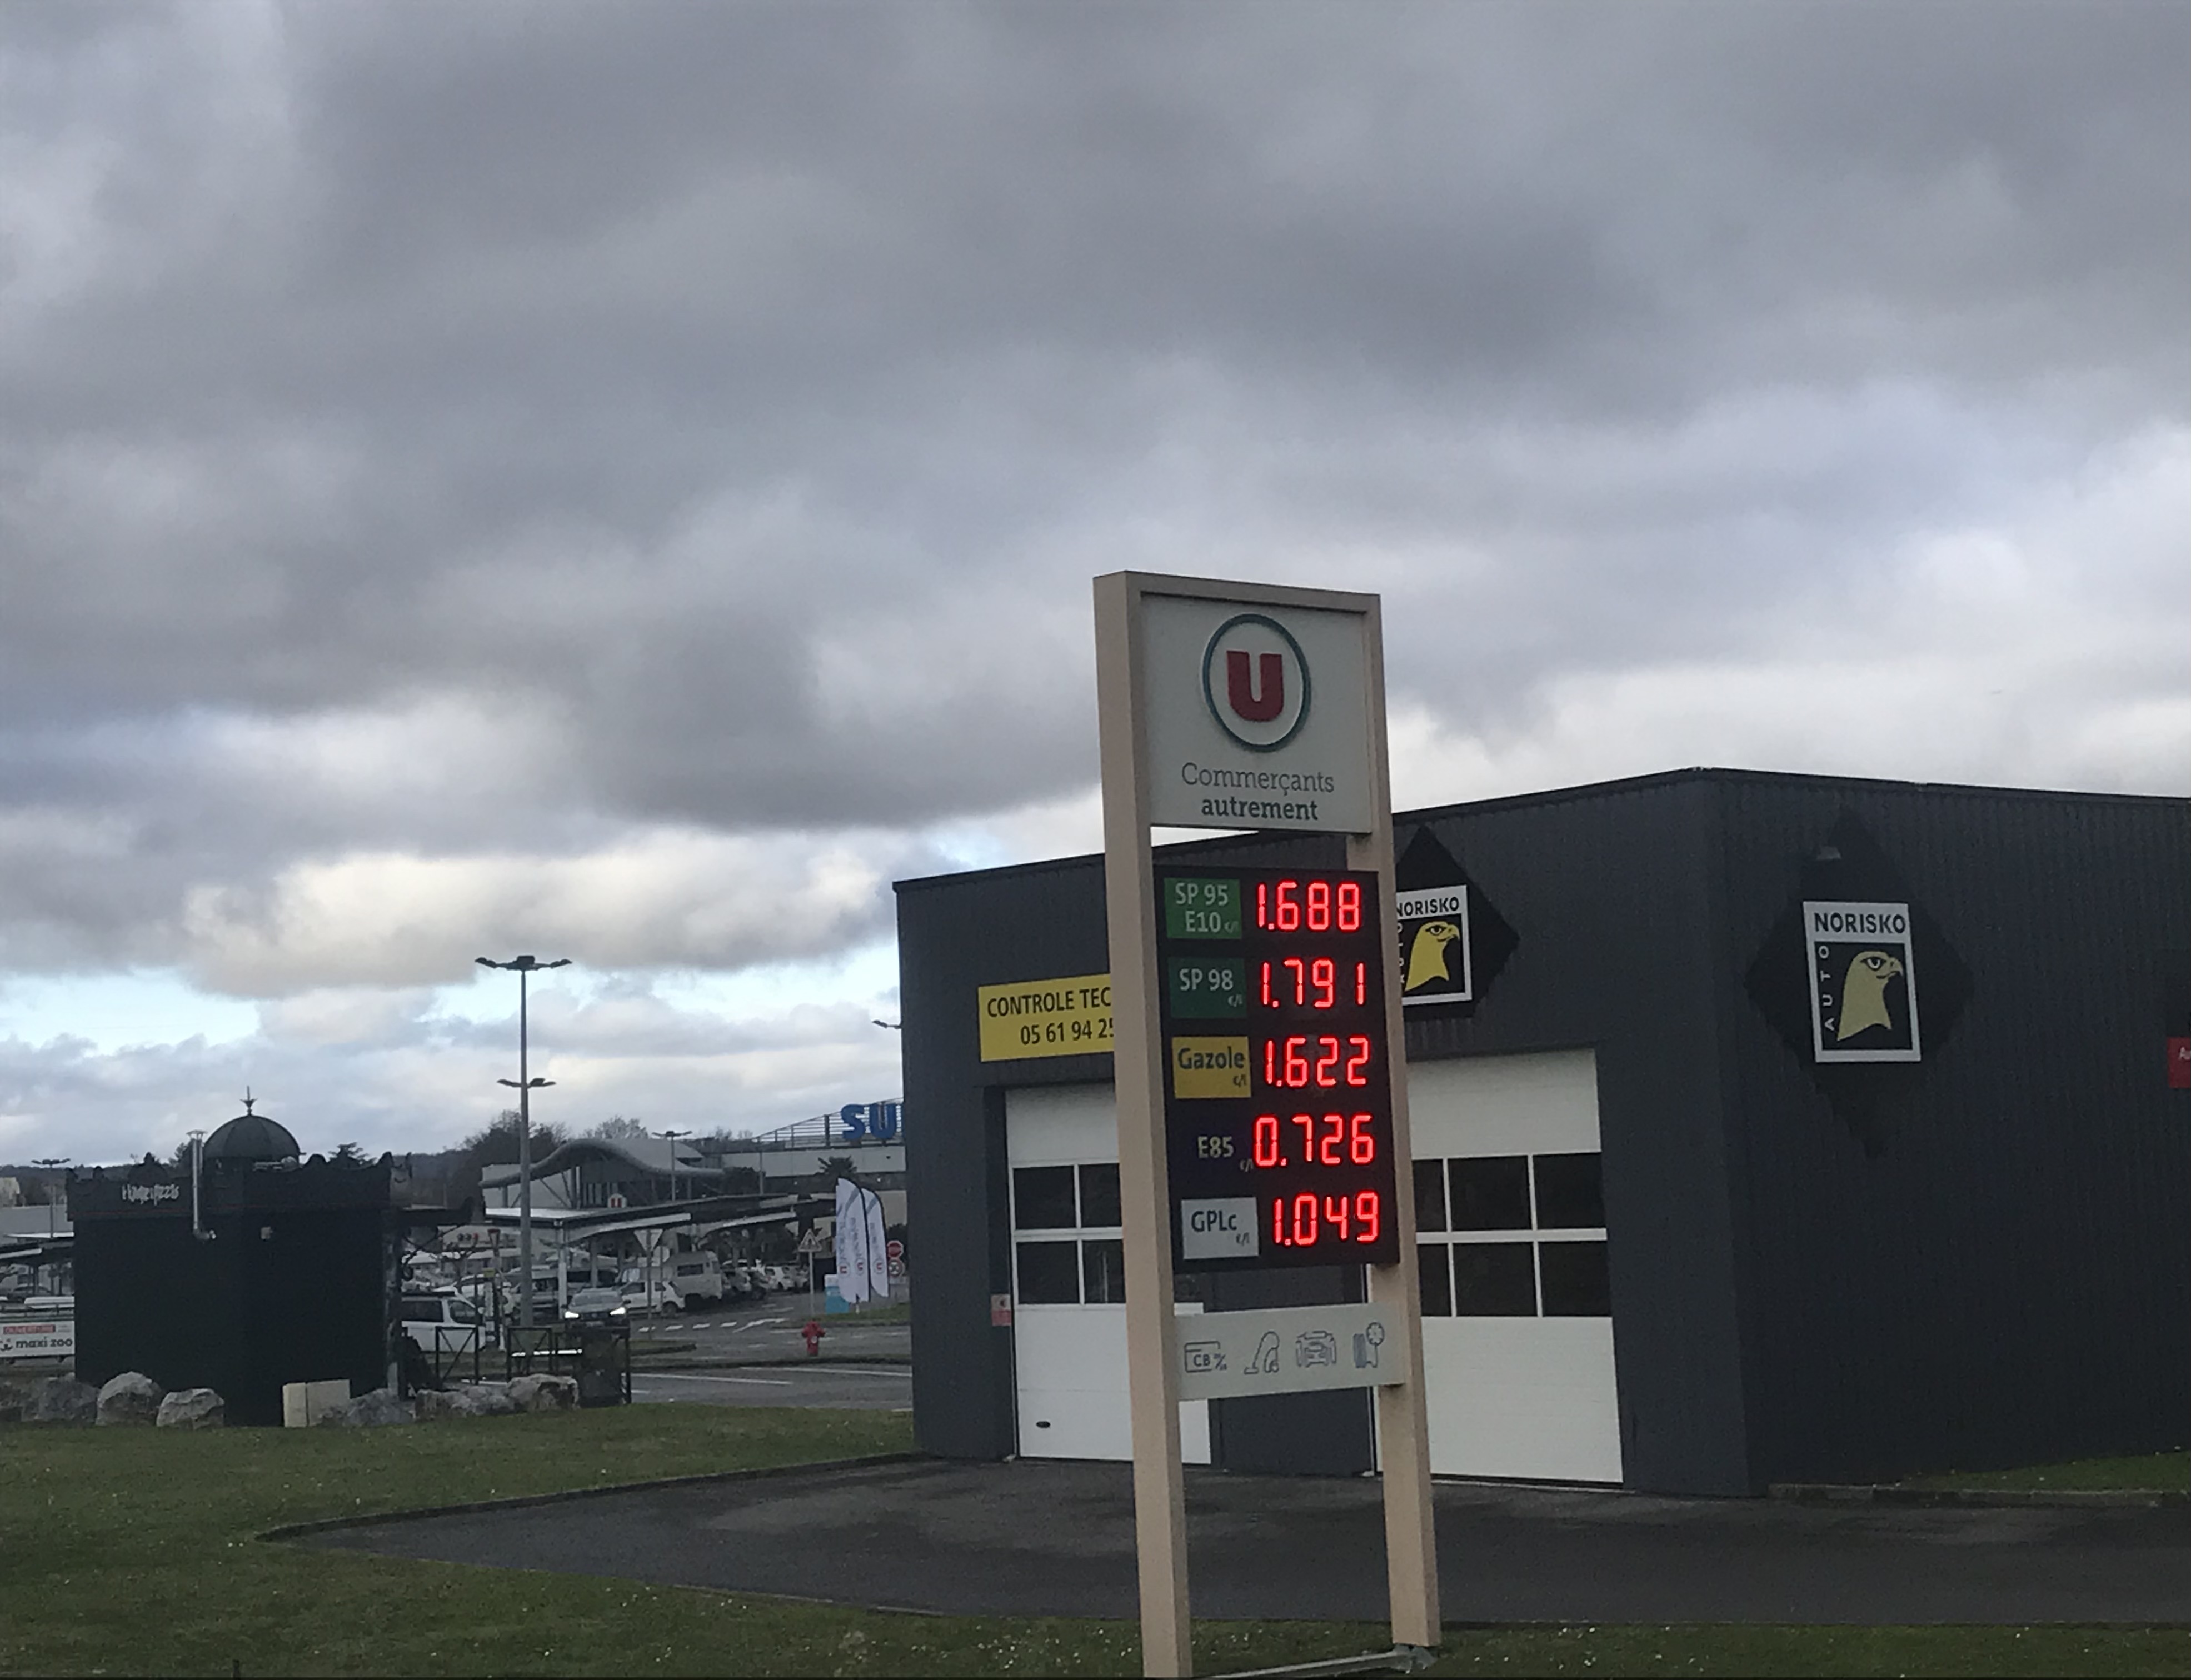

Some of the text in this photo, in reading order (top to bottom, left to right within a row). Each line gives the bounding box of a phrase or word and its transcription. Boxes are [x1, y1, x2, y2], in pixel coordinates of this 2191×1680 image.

[1226, 651, 1284, 722] U
[1181, 762, 1334, 796] Commerçants
[1201, 796, 1319, 821] autrement
[1175, 882, 1228, 906] SP 95
[1258, 882, 1361, 931] 1.688
[1185, 910, 1221, 933] E10
[1814, 912, 1906, 934] NORISKO
[1179, 969, 1234, 991] SP 98
[1262, 959, 1365, 1008] 1.791
[1818, 945, 1835, 1031] AUTO
[987, 987, 1111, 1017] CONTROLE TEC
[1020, 1024, 1040, 1045] 05
[1046, 1022, 1064, 1043] 61
[1071, 1020, 1092, 1041] 94
[1177, 1046, 1245, 1069] Gazole
[1266, 1037, 1369, 1087] 1.622
[841, 1103, 904, 1139] SU
[1197, 1136, 1234, 1158] E85
[1255, 1114, 1374, 1167] 0.726
[1191, 1210, 1237, 1232] GPLc
[1274, 1191, 1379, 1246] 1.049
[16, 1336, 73, 1348] maxi zoo
[1192, 1353, 1210, 1367] CB
